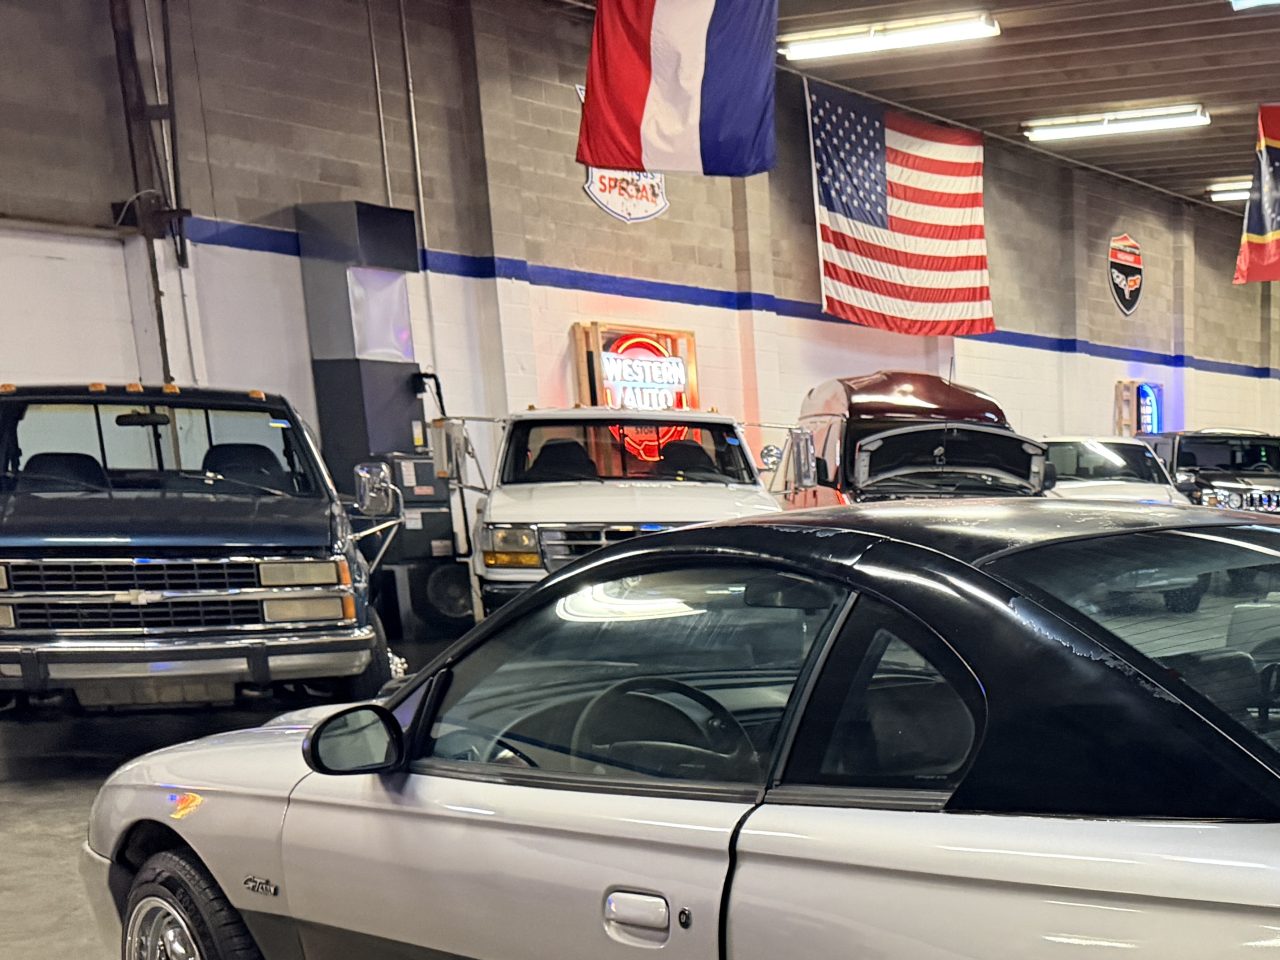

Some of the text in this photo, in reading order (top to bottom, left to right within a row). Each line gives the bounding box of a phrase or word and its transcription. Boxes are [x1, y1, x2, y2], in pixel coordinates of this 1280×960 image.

[598, 175, 657, 205] SPECIAL
[603, 355, 686, 385] WESTERN
[622, 385, 675, 411] AUTO
